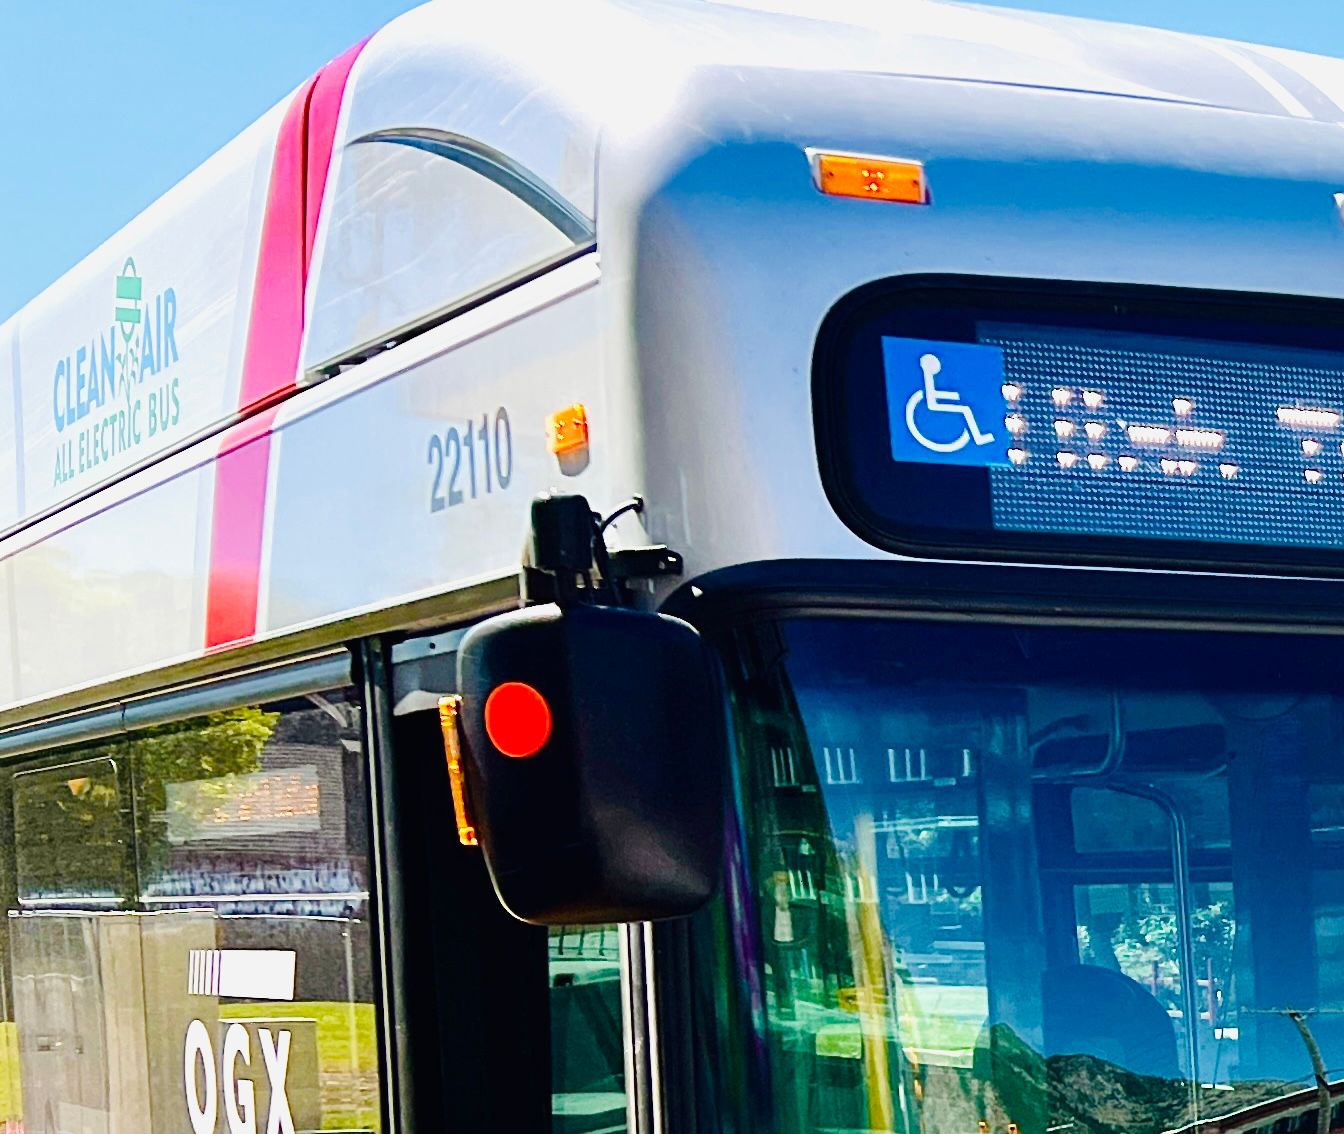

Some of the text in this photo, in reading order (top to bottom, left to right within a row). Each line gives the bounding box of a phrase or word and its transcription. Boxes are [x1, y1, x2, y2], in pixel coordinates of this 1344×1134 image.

[53, 287, 179, 433] CLEAN AIR
[53, 377, 180, 488] ALL ELECTRIC BUS
[427, 405, 513, 513] 22110
